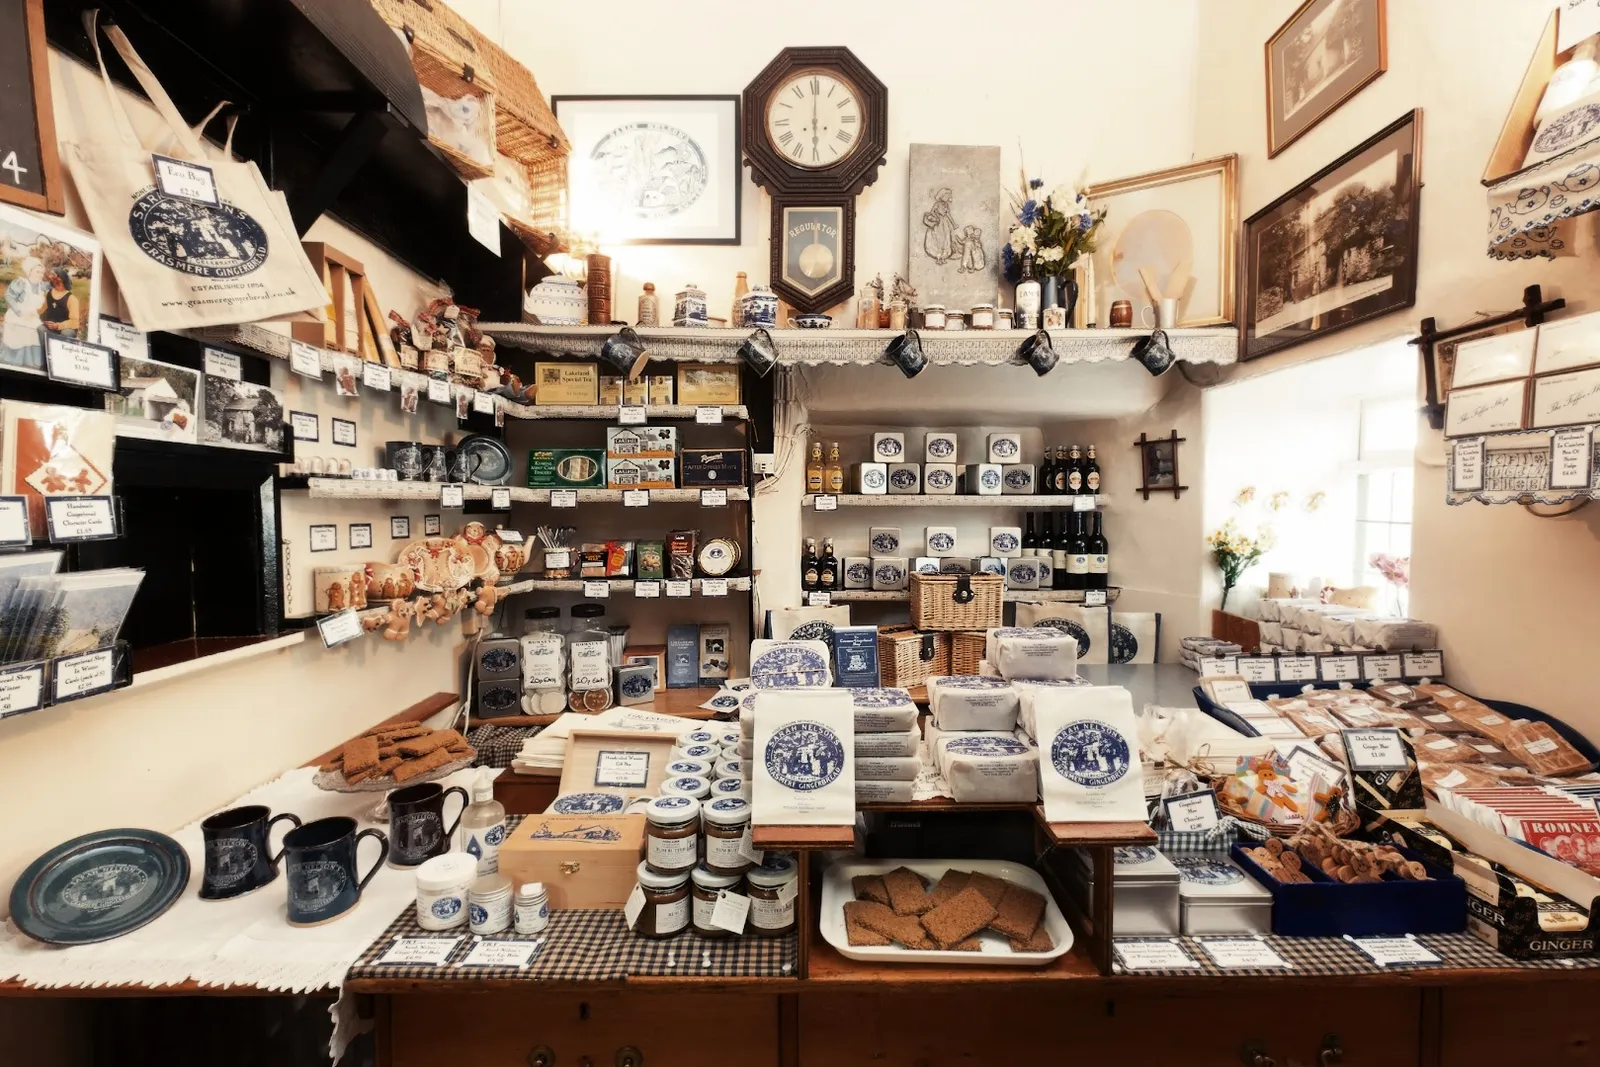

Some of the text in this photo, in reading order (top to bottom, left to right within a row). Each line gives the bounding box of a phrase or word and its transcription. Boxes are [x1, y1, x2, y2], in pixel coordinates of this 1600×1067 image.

[167, 166, 206, 186] Eco Bag
[789, 223, 837, 239] REGULATOR
[141, 242, 267, 276] GRASMERE GINGERBREAD
[161, 287, 296, 309] www.grasmeregingerbread.co.uk
[192, 284, 245, 292] ESTABLISHED
[755, 649, 781, 668] SARAH
[769, 726, 797, 748] SARAH
[802, 724, 840, 746] NELSON'S
[1054, 724, 1124, 746] SARAH NELSON'S
[767, 761, 796, 788] GRASMERE
[798, 767, 841, 789] GINGERBREAD
[1054, 760, 1128, 785] GRASMERE GINGERBREAD
[1530, 940, 1594, 951] GINGER
